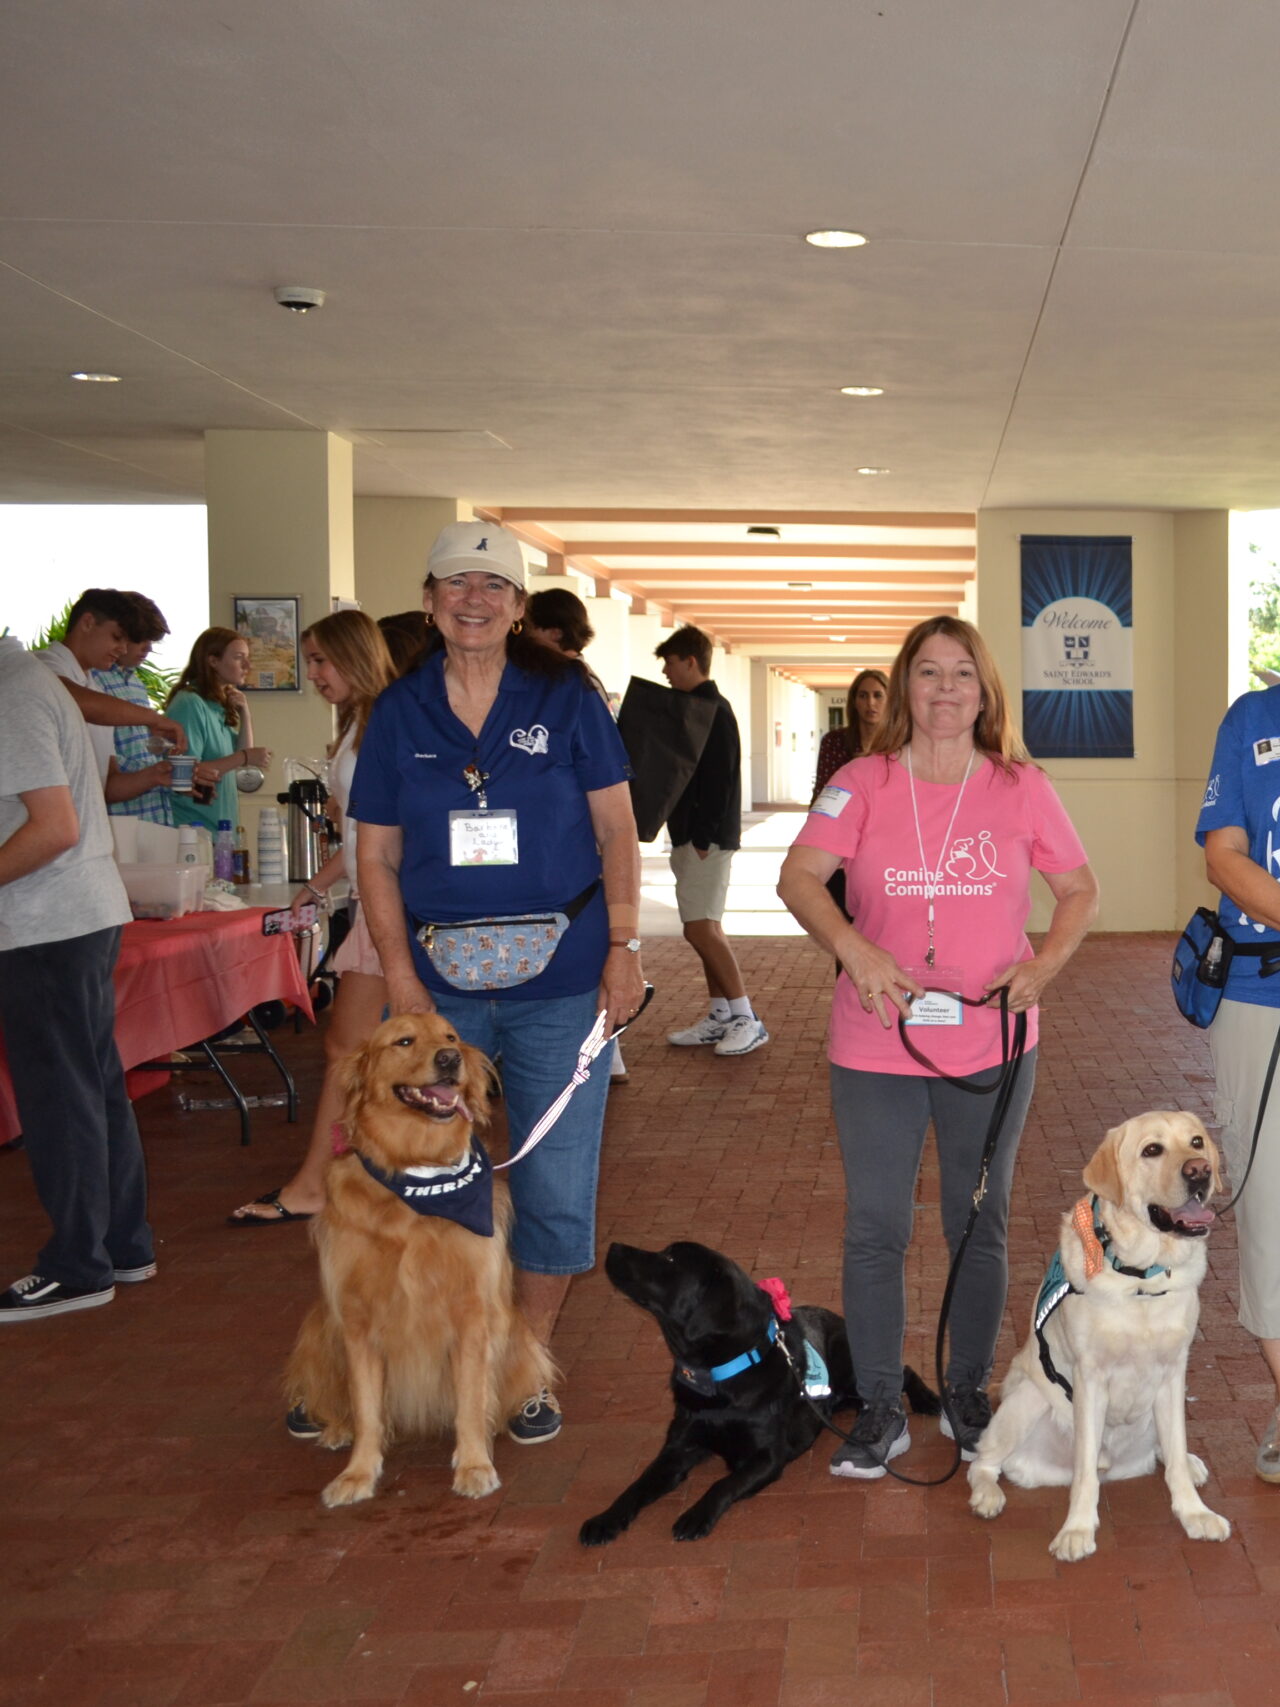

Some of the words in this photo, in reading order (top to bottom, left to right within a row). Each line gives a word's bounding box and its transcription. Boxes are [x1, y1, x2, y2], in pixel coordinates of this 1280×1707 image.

[1043, 611, 1112, 629] Welcome
[1043, 670, 1068, 678] SAINT
[884, 867, 944, 882] Canine
[885, 881, 993, 899] Companions
